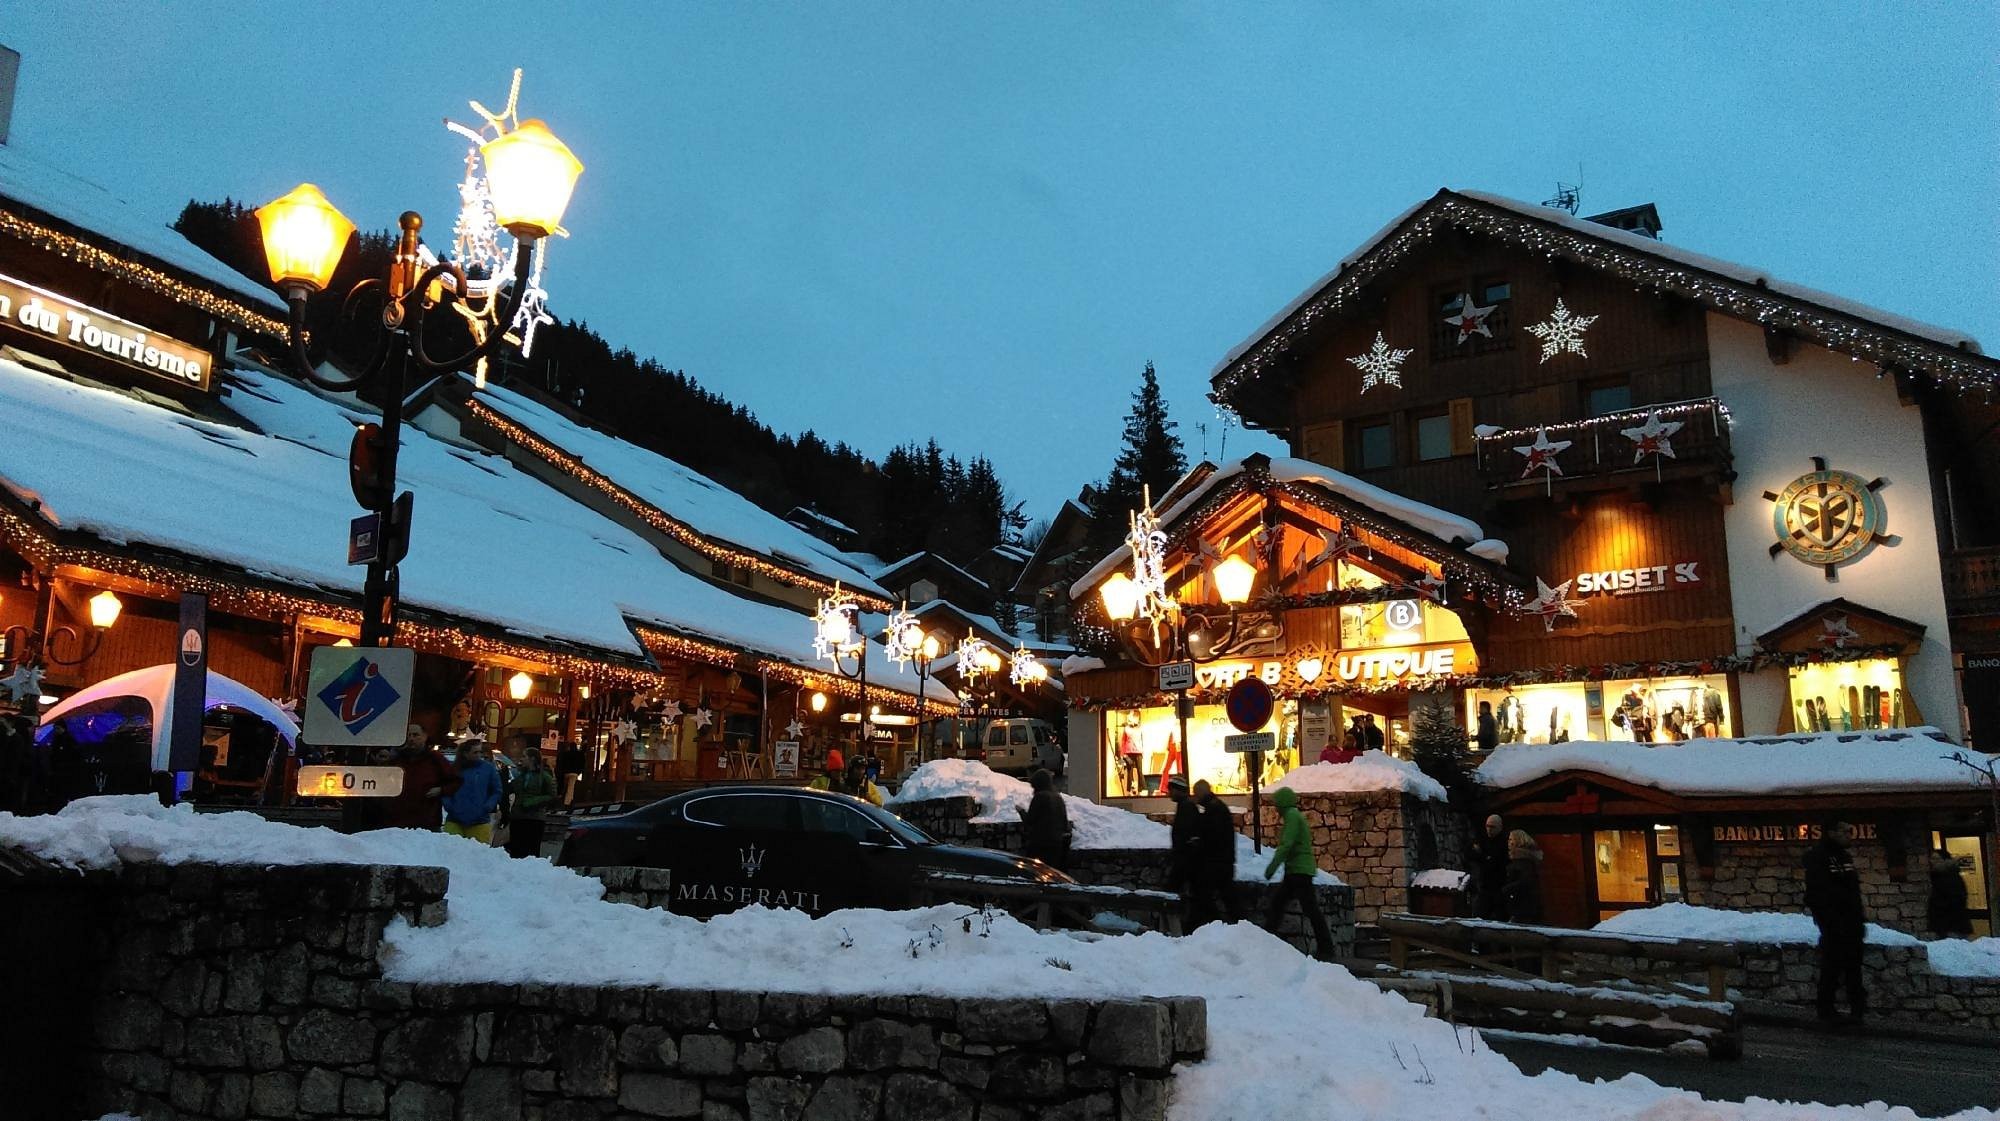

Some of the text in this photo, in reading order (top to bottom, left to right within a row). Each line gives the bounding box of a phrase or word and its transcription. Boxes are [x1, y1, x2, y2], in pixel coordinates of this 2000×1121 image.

[18, 297, 60, 335] du
[66, 310, 201, 382] Tourisme
[1576, 565, 1668, 593] SKISET
[362, 779, 376, 790] m
[1714, 825, 1785, 841] BANQUE
[1787, 824, 1809, 840] DE
[677, 884, 821, 911] MASERATI
